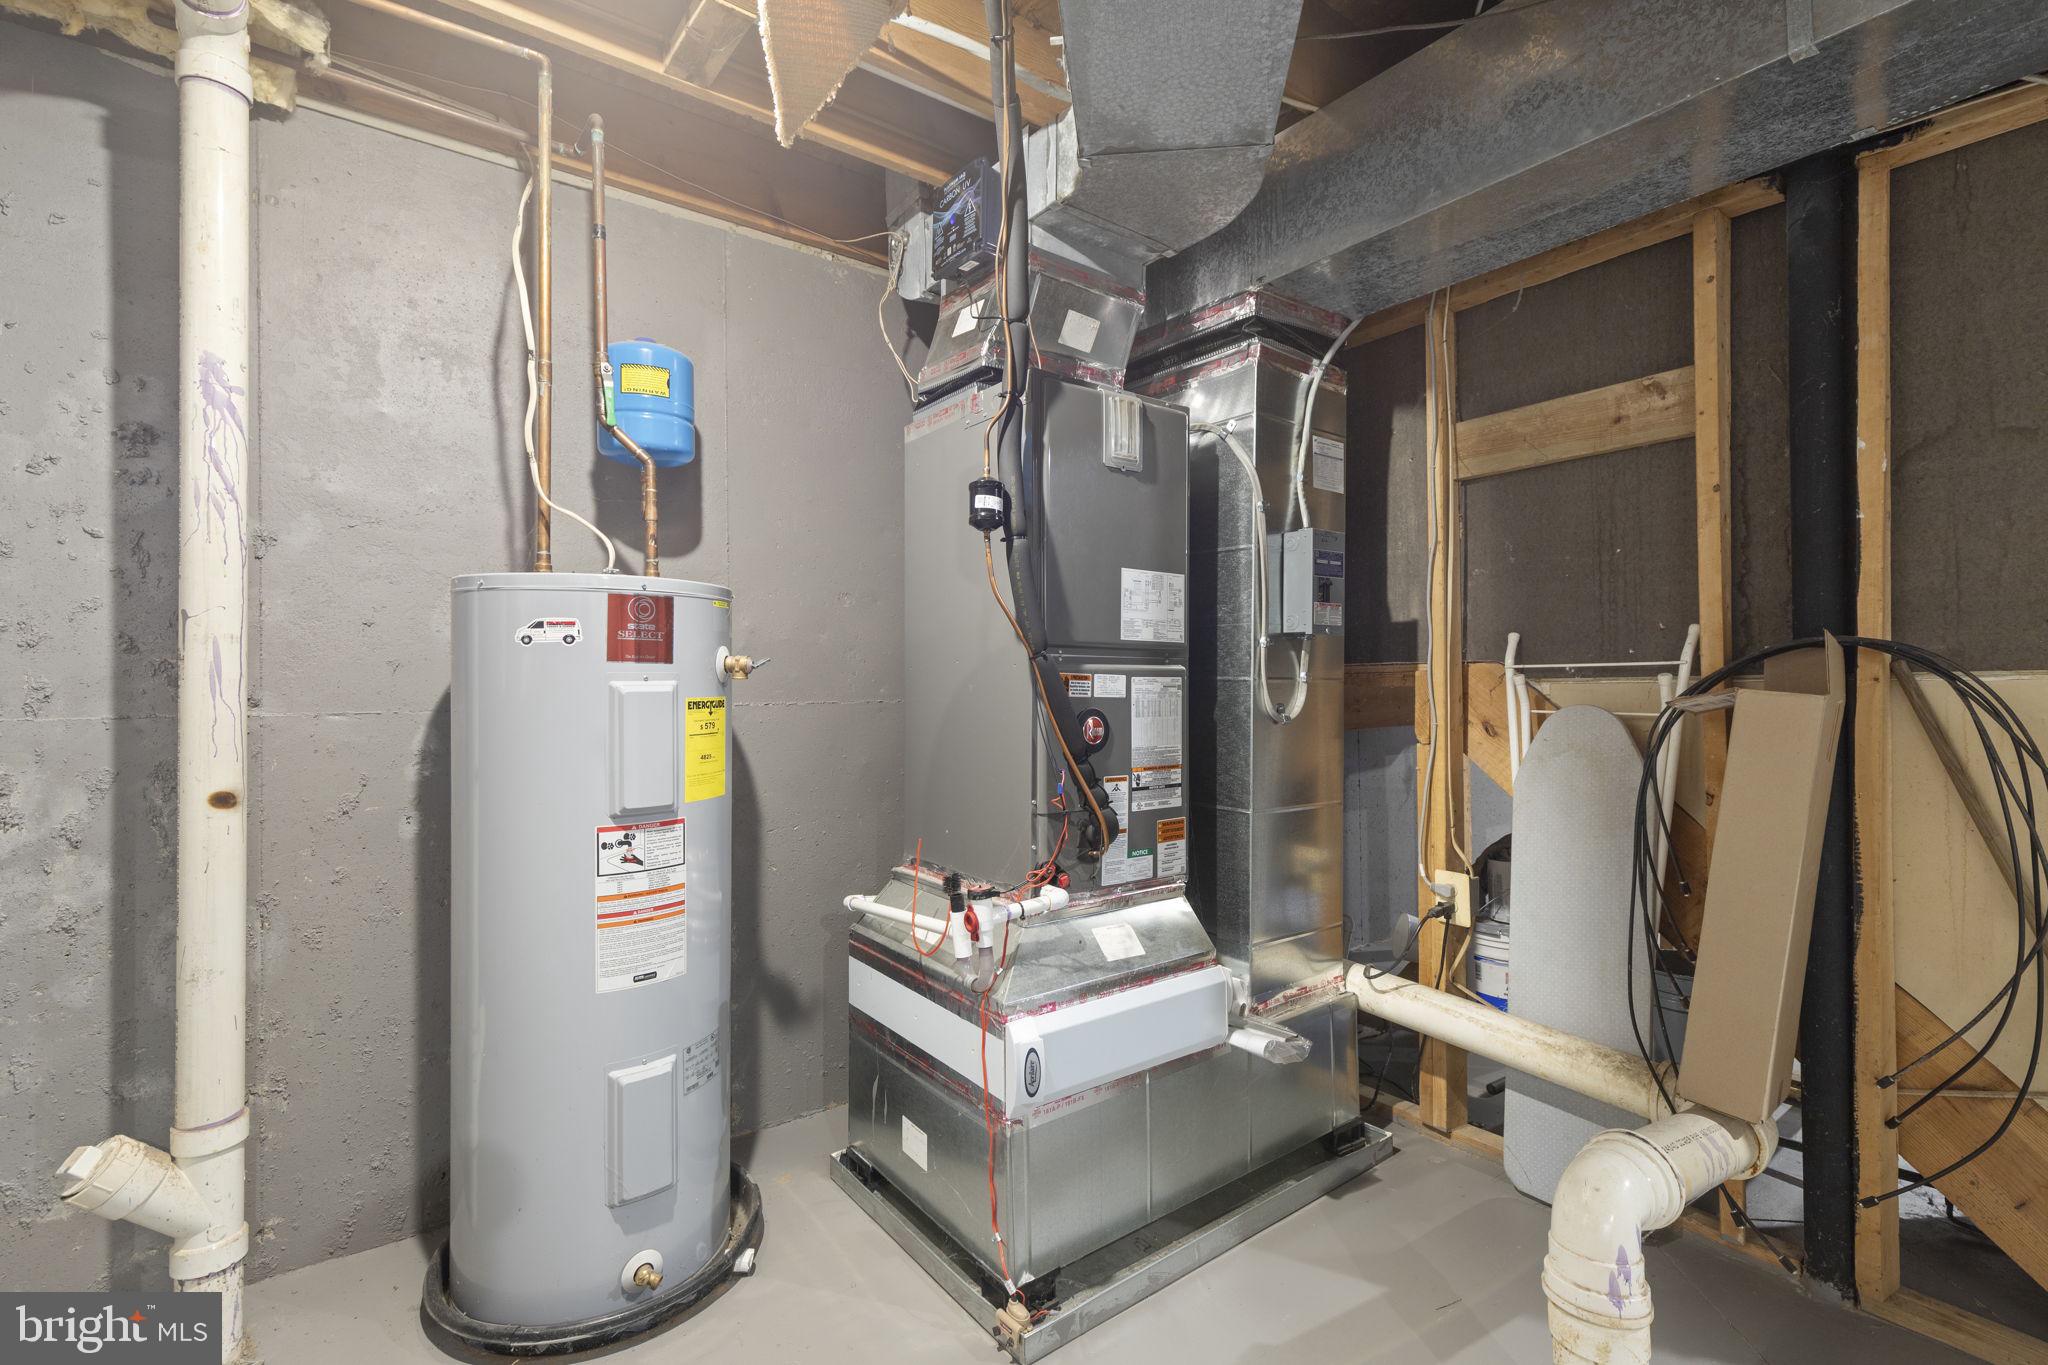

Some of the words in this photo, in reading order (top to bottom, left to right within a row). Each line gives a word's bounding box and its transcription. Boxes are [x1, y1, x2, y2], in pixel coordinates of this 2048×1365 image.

[962, 179, 971, 190] UV
[617, 630, 665, 639] SELECT
[704, 722, 716, 730] 579
